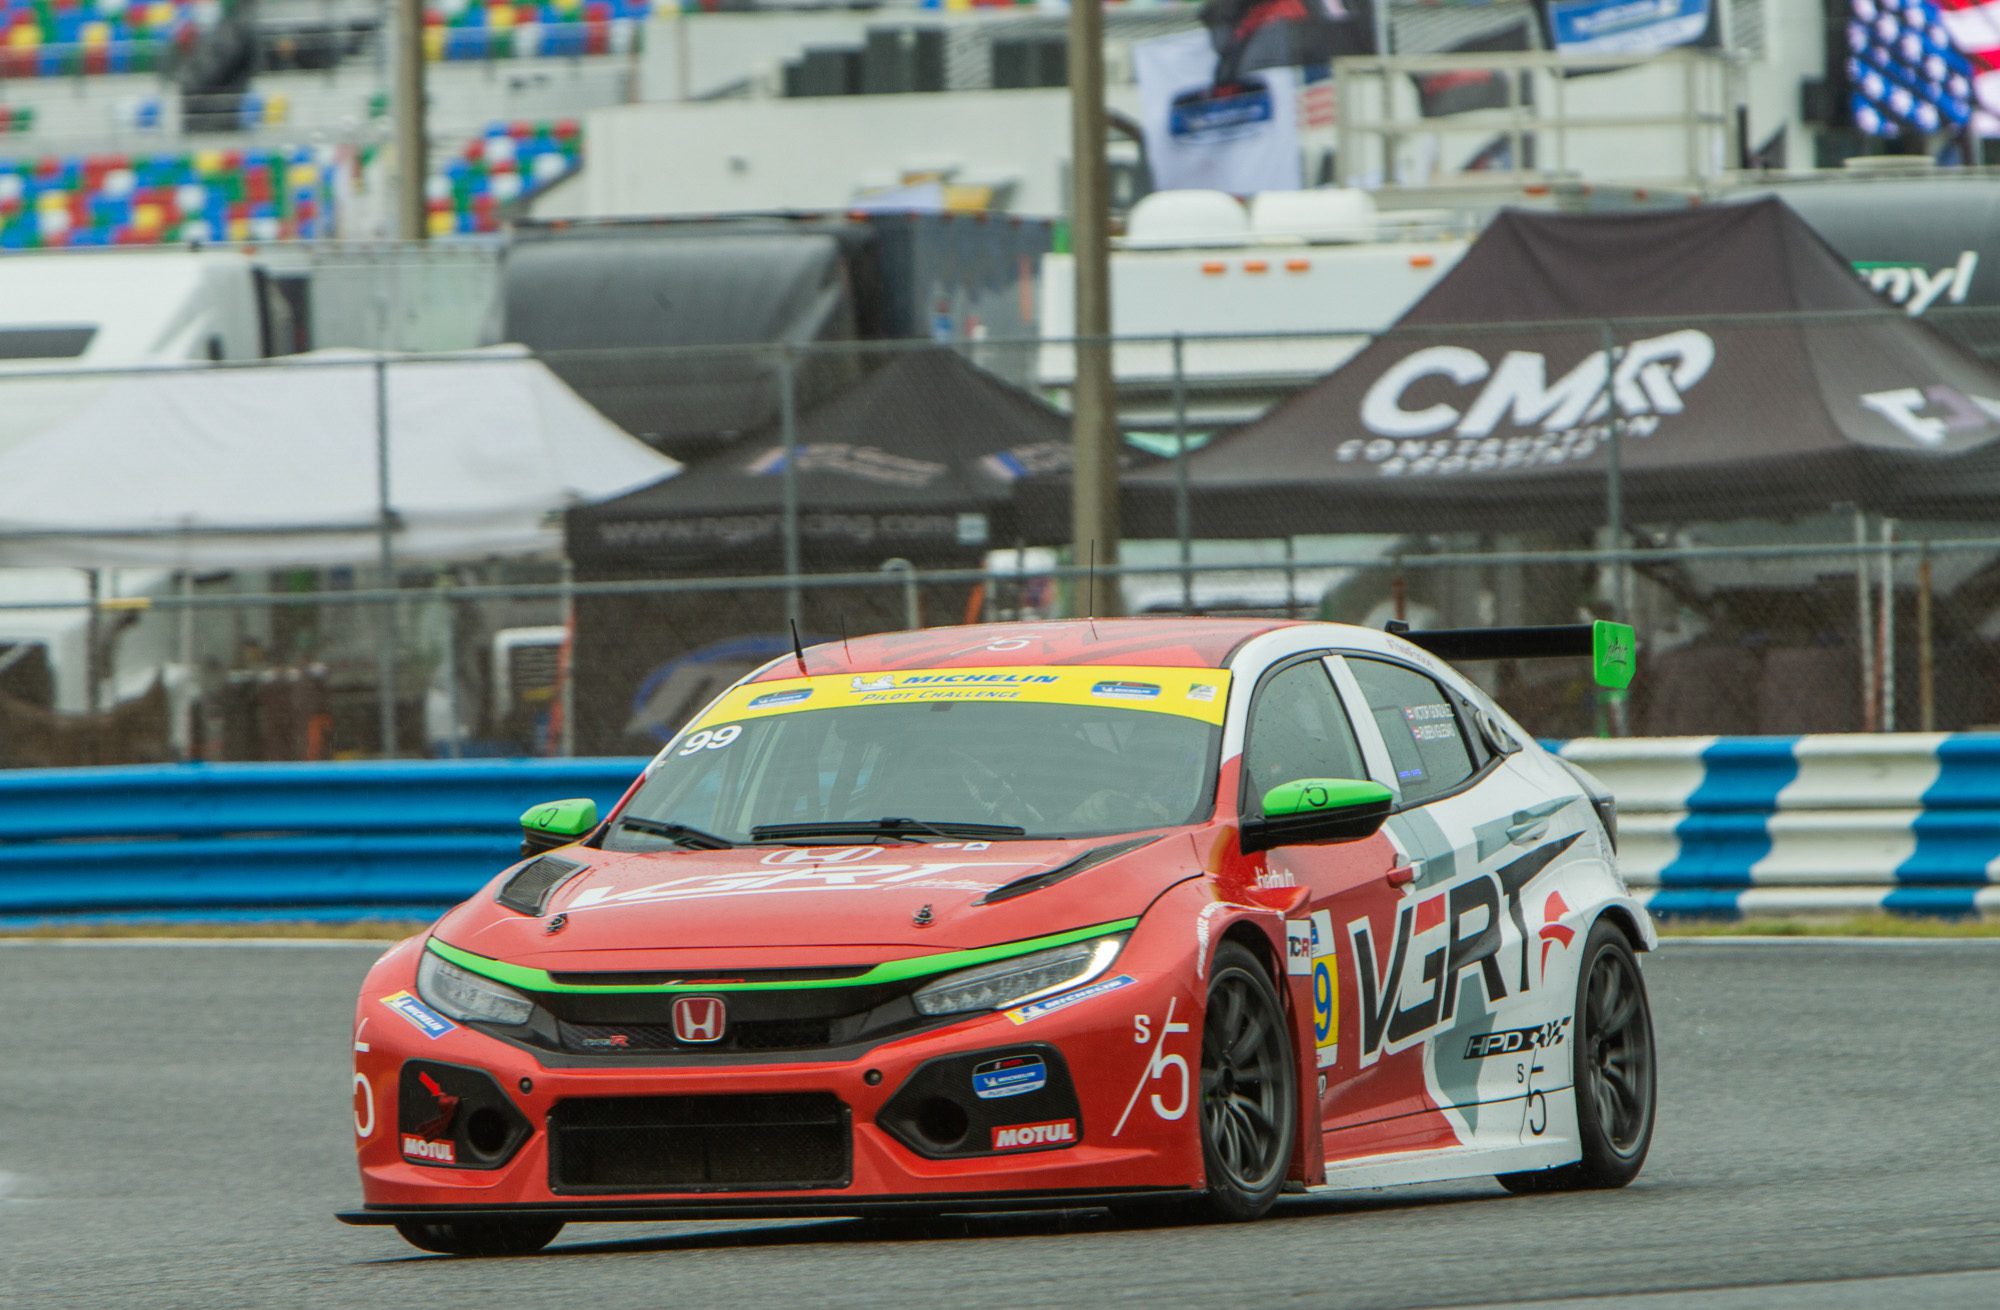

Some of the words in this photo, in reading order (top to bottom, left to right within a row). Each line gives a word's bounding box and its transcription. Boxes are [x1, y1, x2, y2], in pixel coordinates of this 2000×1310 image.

[902, 674, 1061, 684] MICHELIN
[860, 692, 914, 702] PILOT
[918, 690, 1021, 699] CHALLENGE
[678, 725, 743, 756] 99
[1288, 935, 1310, 958] TCR
[1044, 980, 1122, 1009] MICHELIN
[403, 1002, 446, 1031] MICHELIN
[1465, 1033, 1524, 1058] HPD
[996, 1122, 1073, 1148] MOTUL
[403, 1137, 454, 1161] MOTUL
